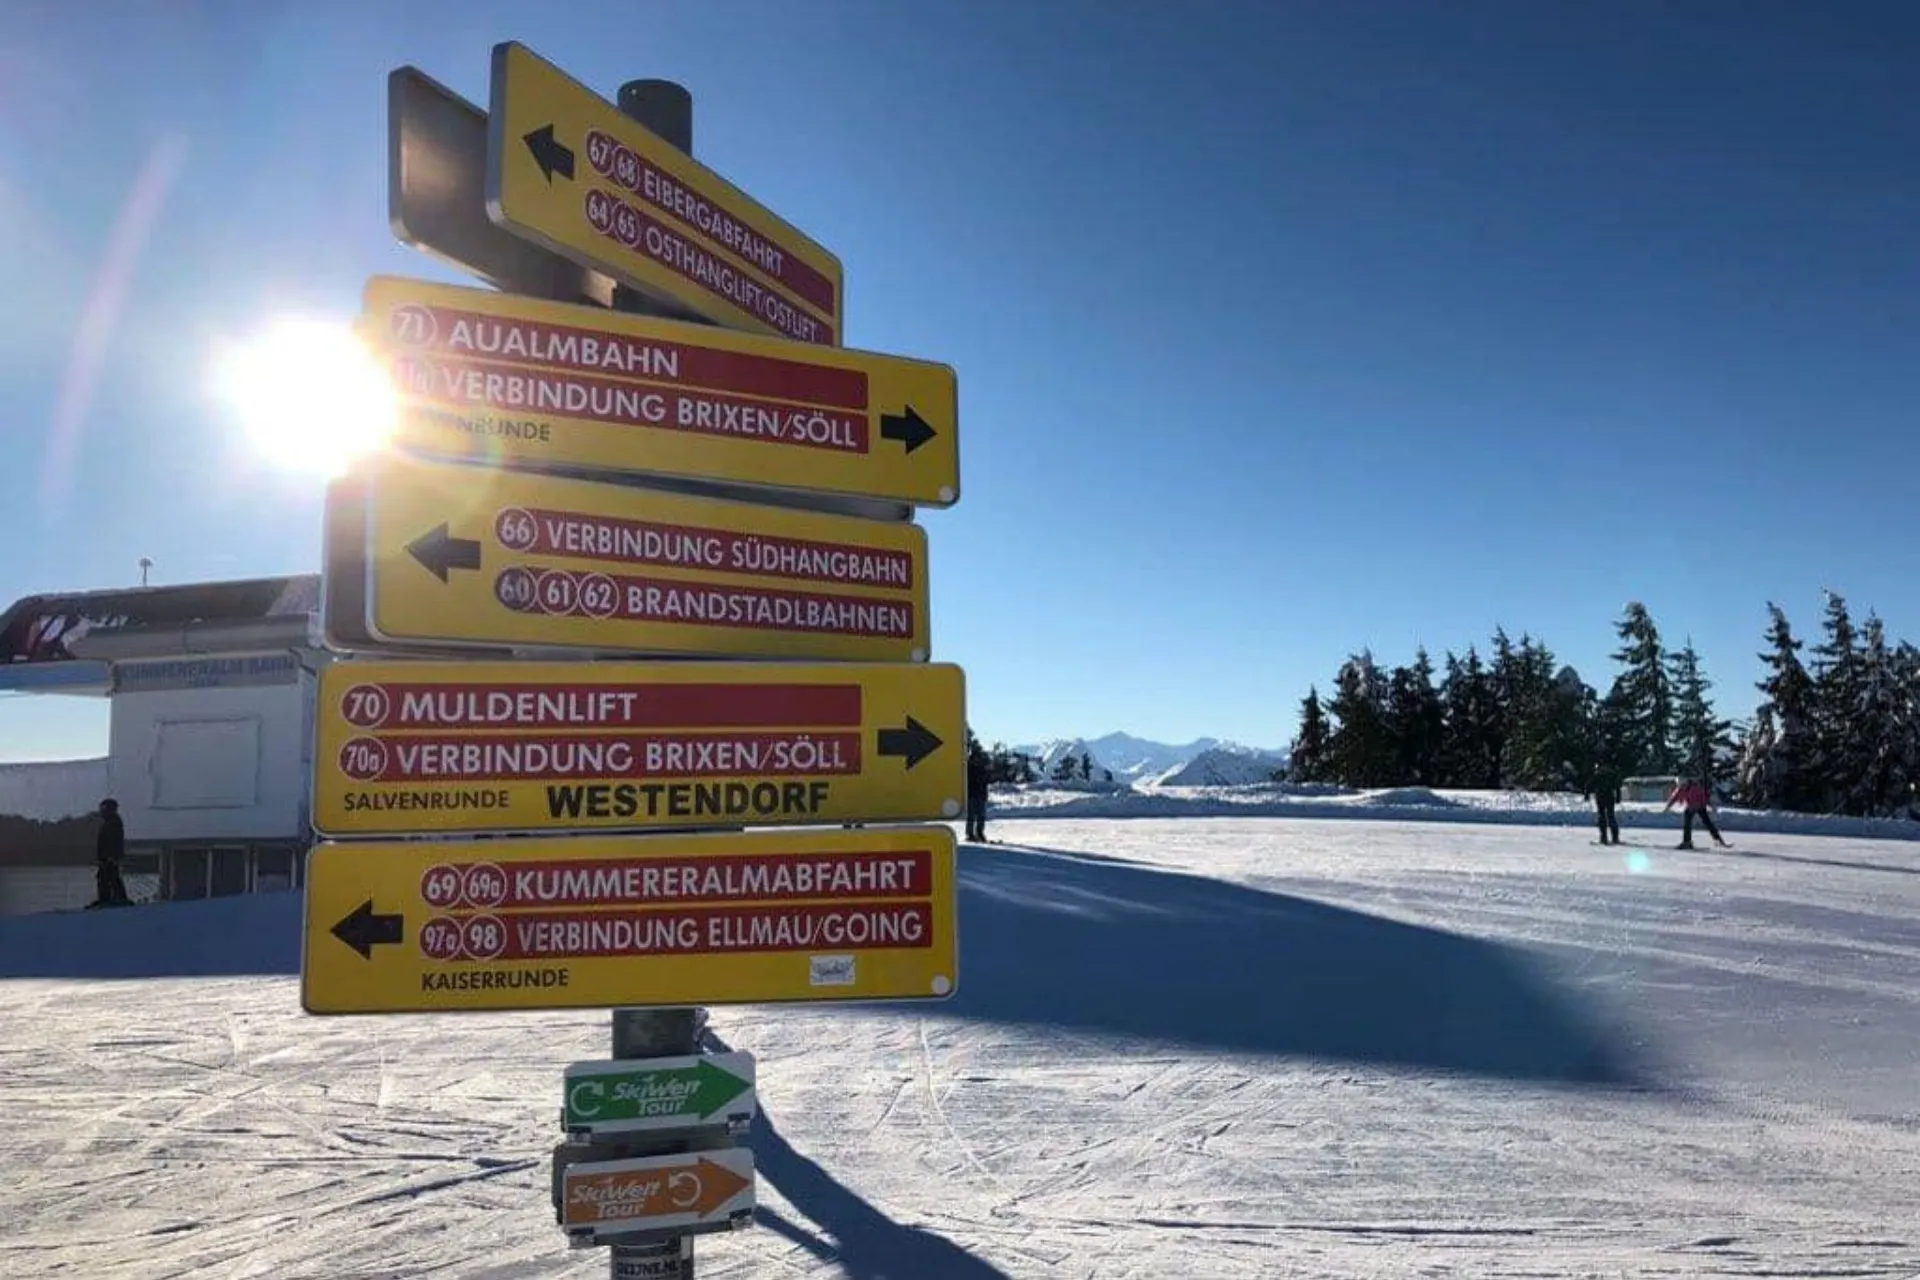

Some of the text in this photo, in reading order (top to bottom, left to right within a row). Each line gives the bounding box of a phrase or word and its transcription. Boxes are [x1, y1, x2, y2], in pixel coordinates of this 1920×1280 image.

[588, 195, 607, 226] 64
[616, 212, 636, 241] 65
[590, 134, 783, 277] 67 68 EIBERGABFAHRT
[398, 312, 425, 339] 71
[449, 319, 679, 378] AUALMBAHN
[443, 362, 666, 422] VERBINDUNG
[677, 396, 857, 447] BRIXEN/SÖLL
[501, 515, 908, 584] 66 VERBINDUNG SÜDHANGBAHN
[500, 579, 908, 633] 60 61 62 BRANDSTADLBAHNEN
[349, 692, 638, 722] 70 MULDENLIFT
[395, 742, 634, 774] VERBINDUNG
[645, 735, 847, 771] BRIXEN/SÖLL
[343, 781, 830, 818] SALVENRUNDE WESTENDORF
[426, 873, 457, 900] 69
[514, 860, 916, 900] KUMMERERALMABFAHRT
[469, 924, 499, 949] 98
[517, 918, 699, 952] VERBINDUNG
[707, 911, 923, 947] ELLMAU/GOING
[420, 968, 570, 992] KAISERRUNDE
[637, 1097, 686, 1116] Tour
[597, 1202, 644, 1219] Tour
